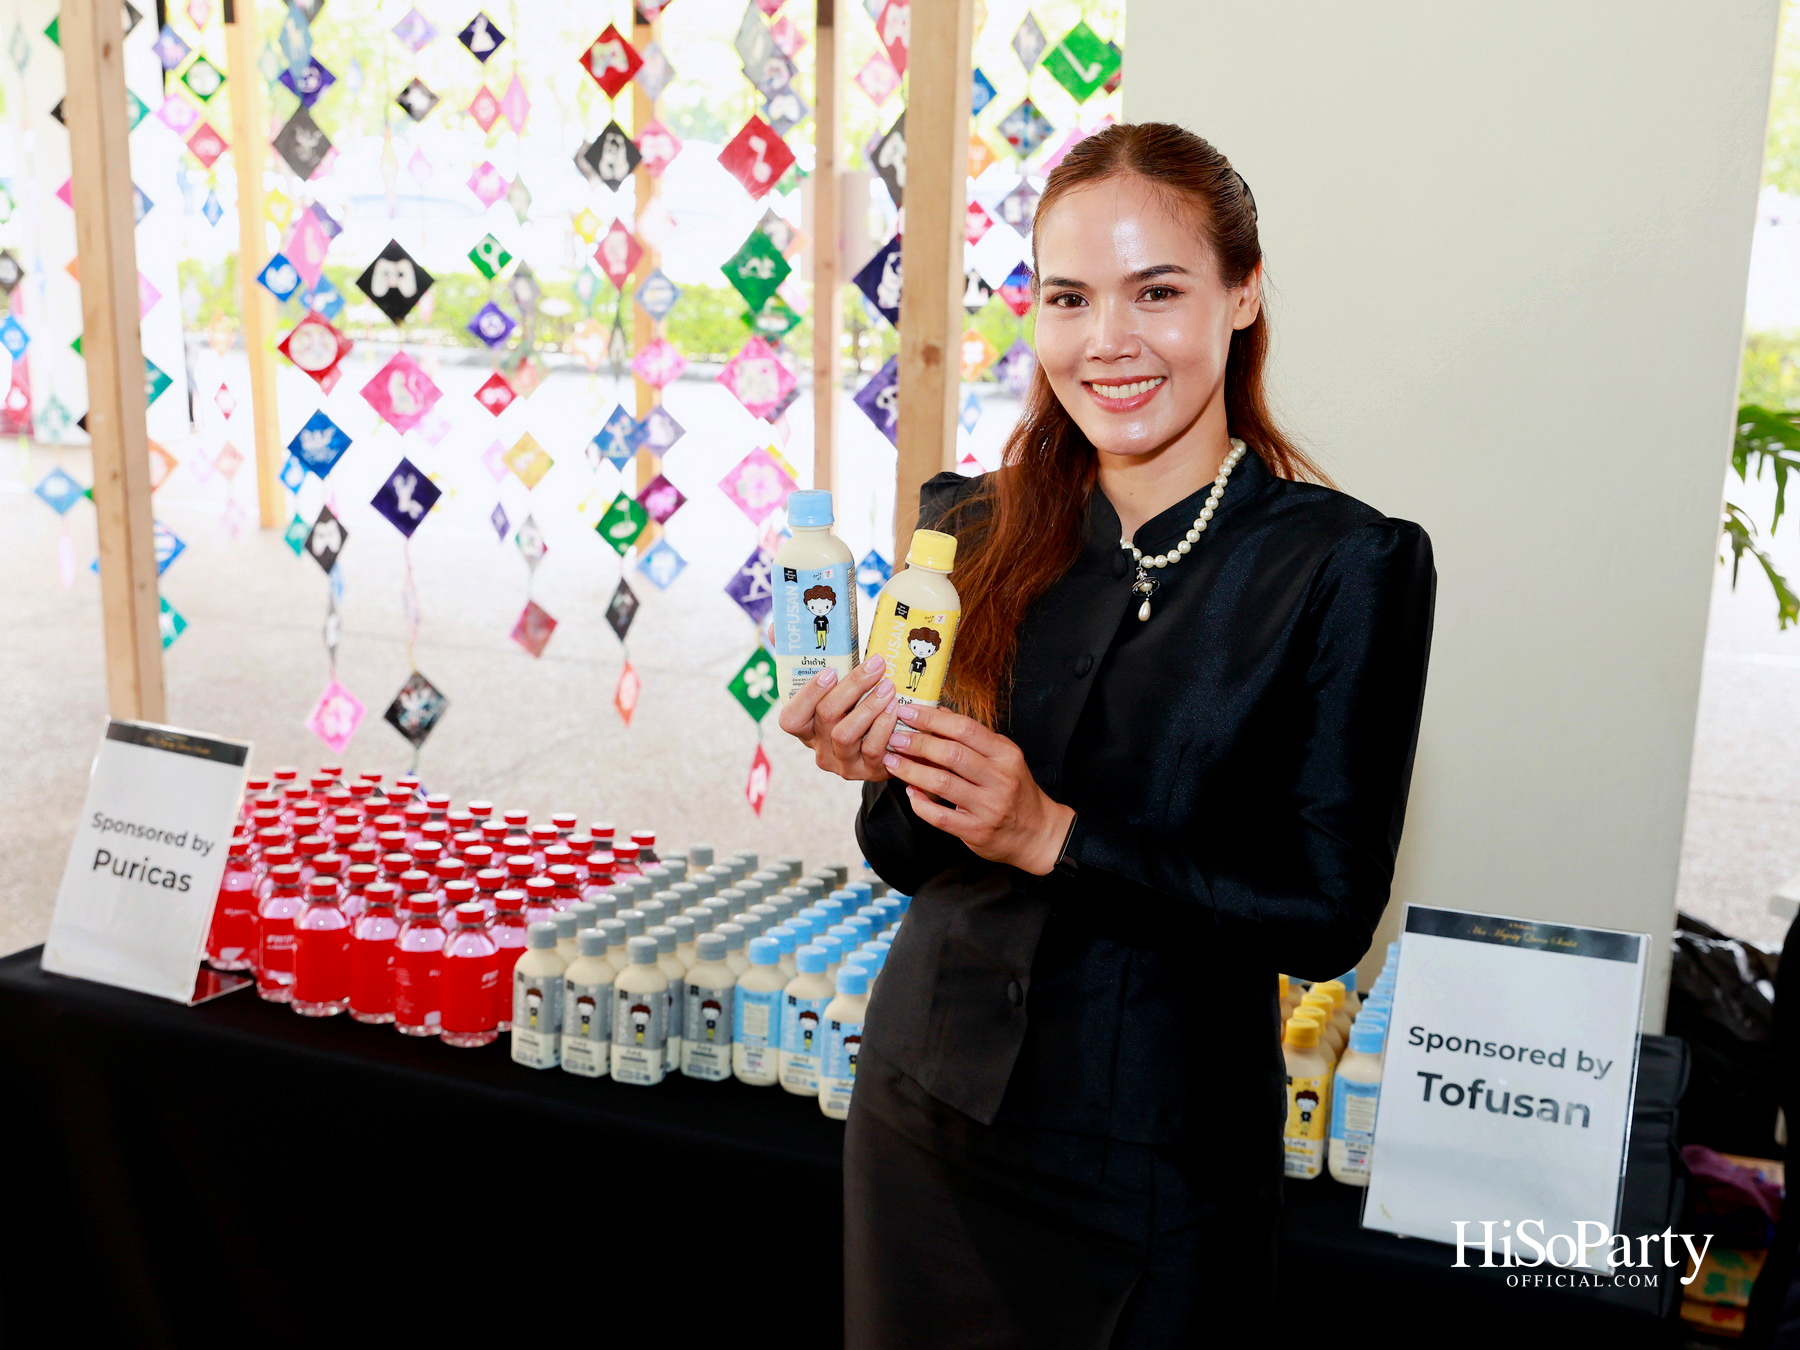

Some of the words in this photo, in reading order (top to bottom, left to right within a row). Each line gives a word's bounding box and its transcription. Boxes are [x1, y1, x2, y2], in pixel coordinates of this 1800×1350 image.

[785, 585, 801, 652] TOFUSAN
[801, 655, 826, 667] น้ำเต้าหู้
[885, 619, 907, 678] OFUSAN
[91, 812, 188, 848] Sponsored
[192, 833, 215, 857] by
[93, 849, 192, 892] Puricas
[1408, 1026, 1566, 1069] Sponsored
[1576, 1051, 1612, 1080] by
[1417, 1071, 1590, 1128] Tofusan
